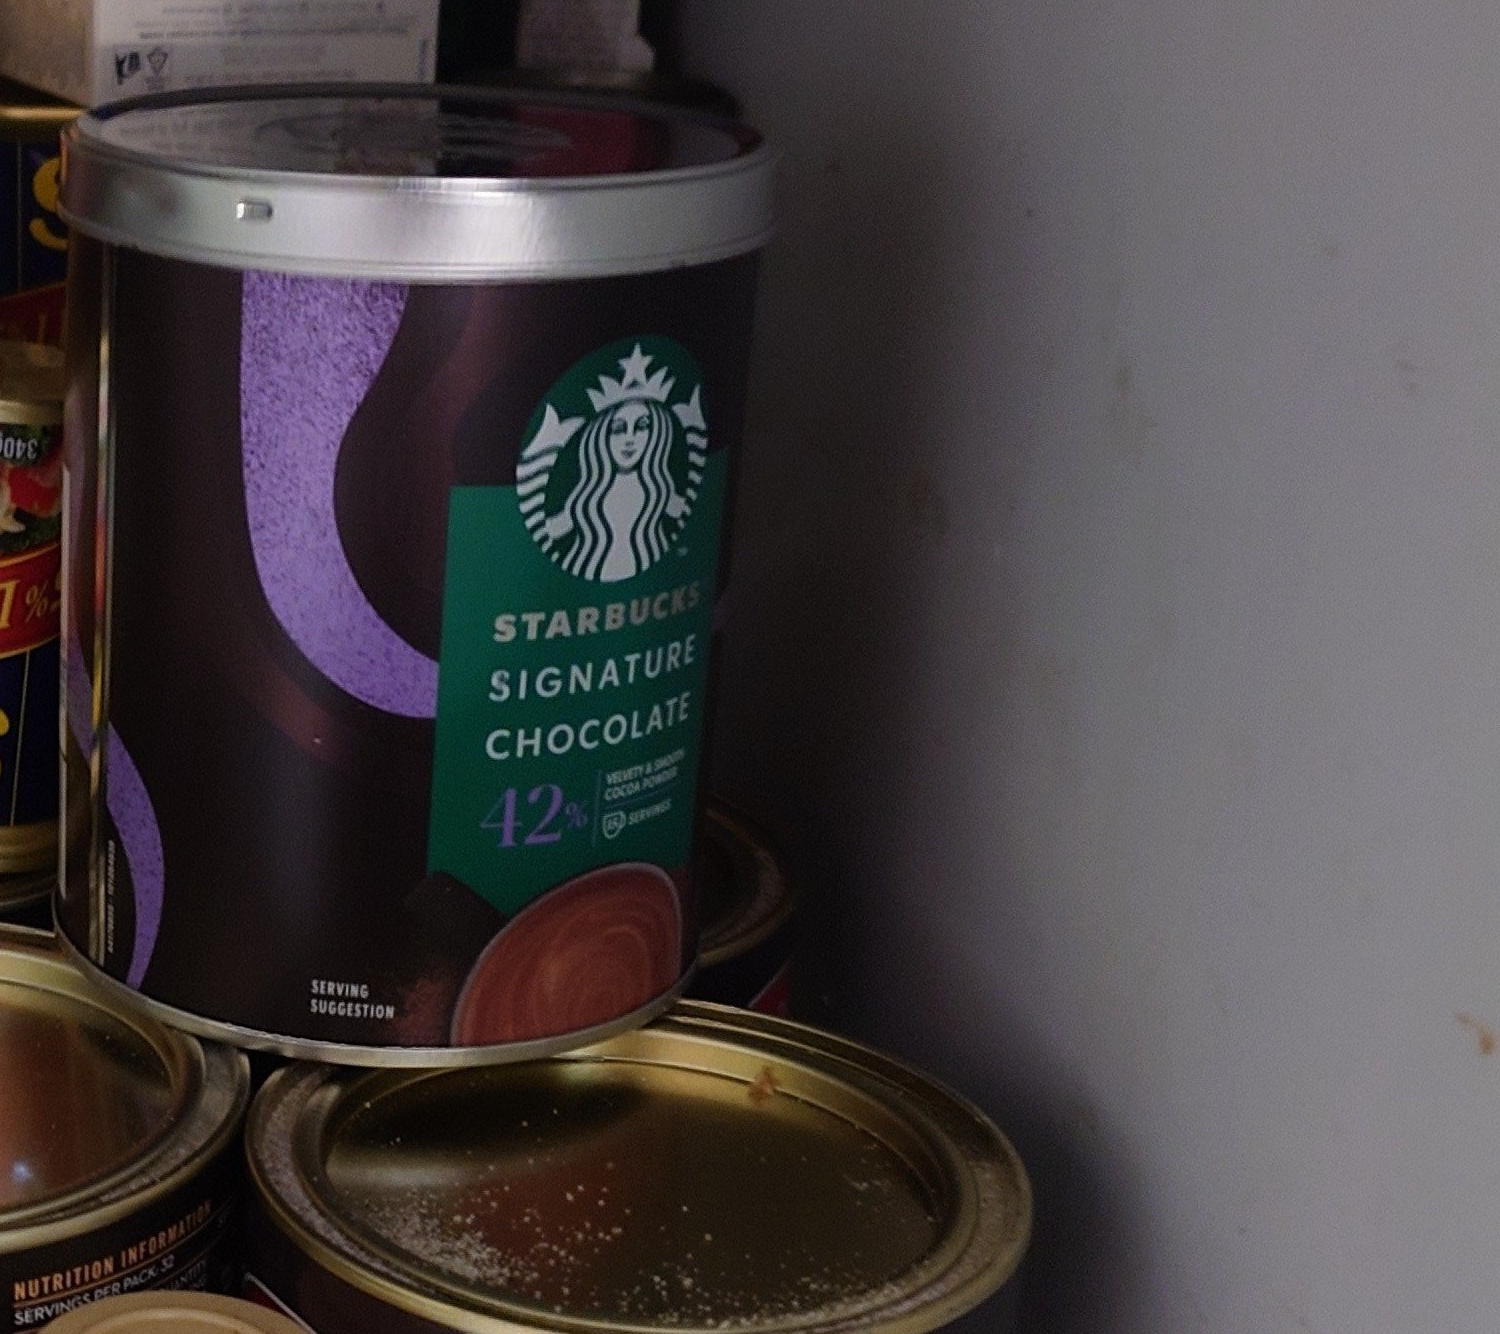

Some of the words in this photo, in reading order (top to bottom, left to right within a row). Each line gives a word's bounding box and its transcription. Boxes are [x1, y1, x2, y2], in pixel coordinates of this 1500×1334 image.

[492, 583, 700, 644] STARBUCKS
[488, 633, 697, 703] SIGNATURE
[484, 690, 692, 761] CHOCOLATE
[310, 998, 396, 1019] SUGGESTION
[311, 979, 370, 999] SERVING
[13, 1255, 114, 1301] NUTRITION
